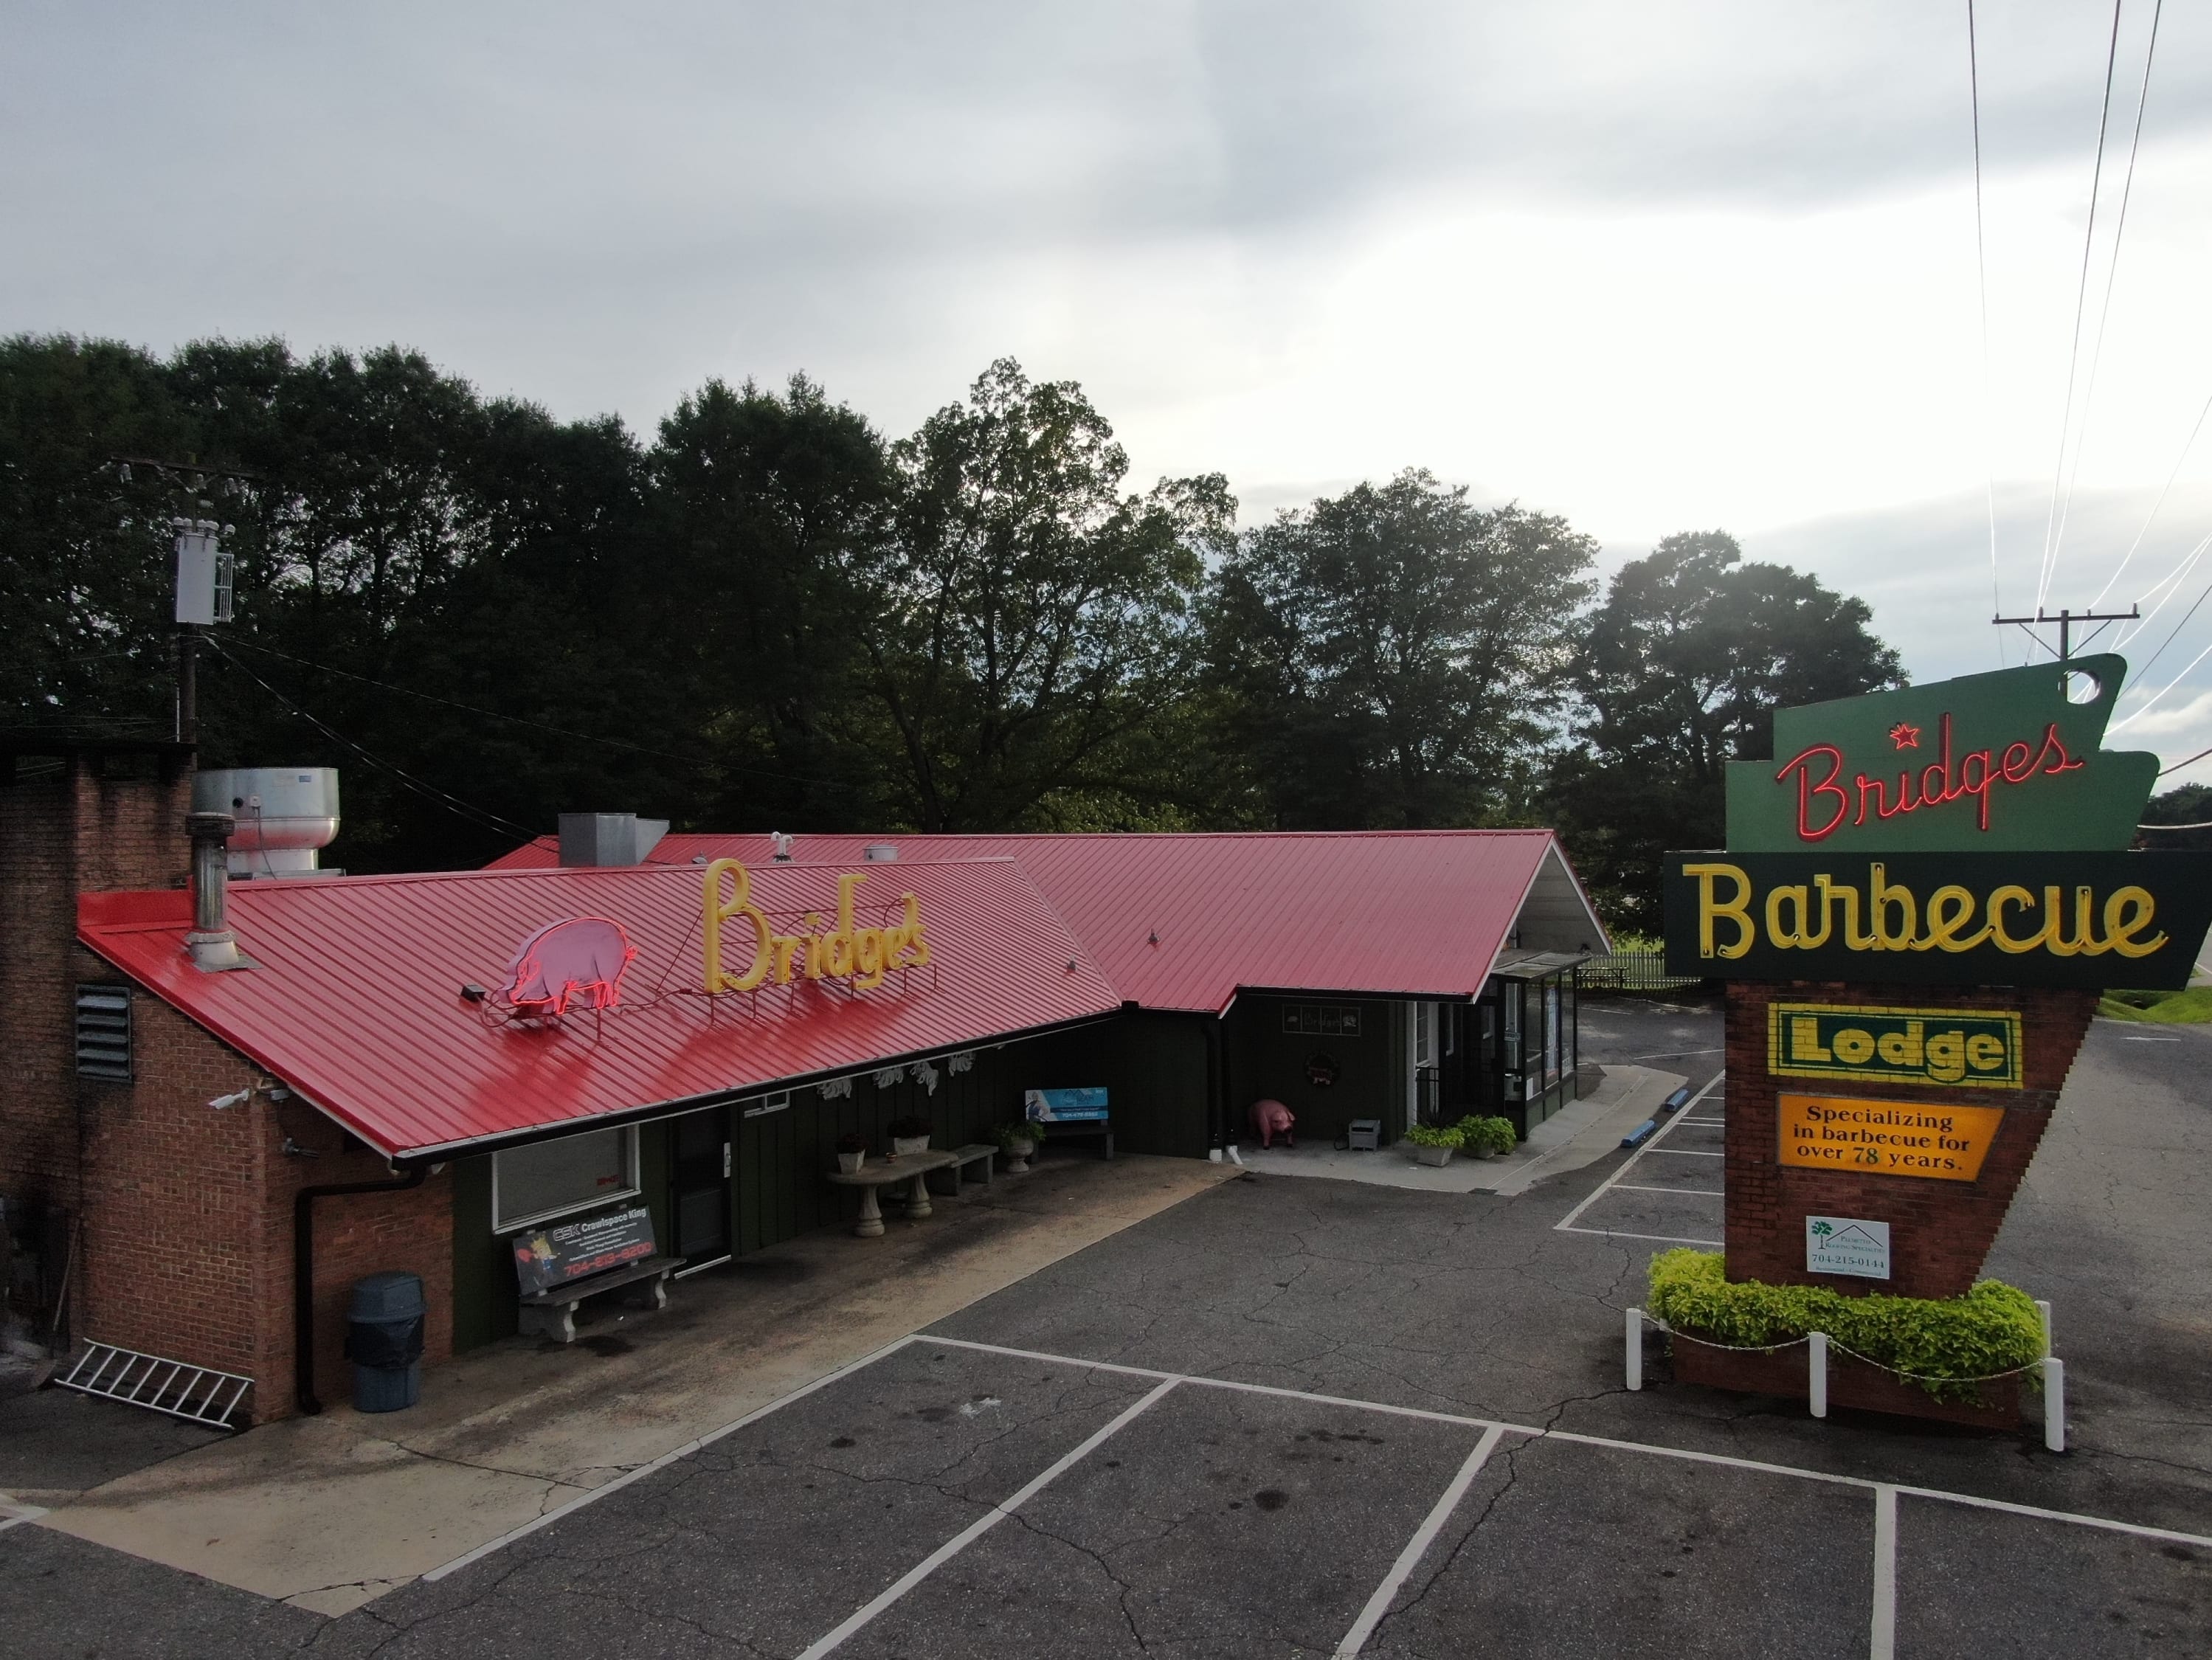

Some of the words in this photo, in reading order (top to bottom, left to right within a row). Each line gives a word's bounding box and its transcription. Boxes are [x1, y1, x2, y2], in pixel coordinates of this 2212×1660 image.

[1775, 712, 2086, 842] Bridges
[703, 858, 931, 993] Bridges
[1682, 862, 2171, 958] Barbecue
[1791, 1017, 2005, 1082] Lodge
[1807, 1105, 1953, 1132] Specializing
[1793, 1124, 1814, 1138] in
[1822, 1126, 1930, 1148] barbecue
[1938, 1135, 1970, 1152] for
[1797, 1145, 1844, 1159] over
[1853, 1147, 1879, 1165] 78
[1889, 1152, 1963, 1170] years.
[553, 1223, 581, 1242] CSK
[581, 1214, 628, 1232] Crawlspace
[628, 1208, 646, 1220] King
[1811, 1254, 1884, 1268] 704-215-0144
